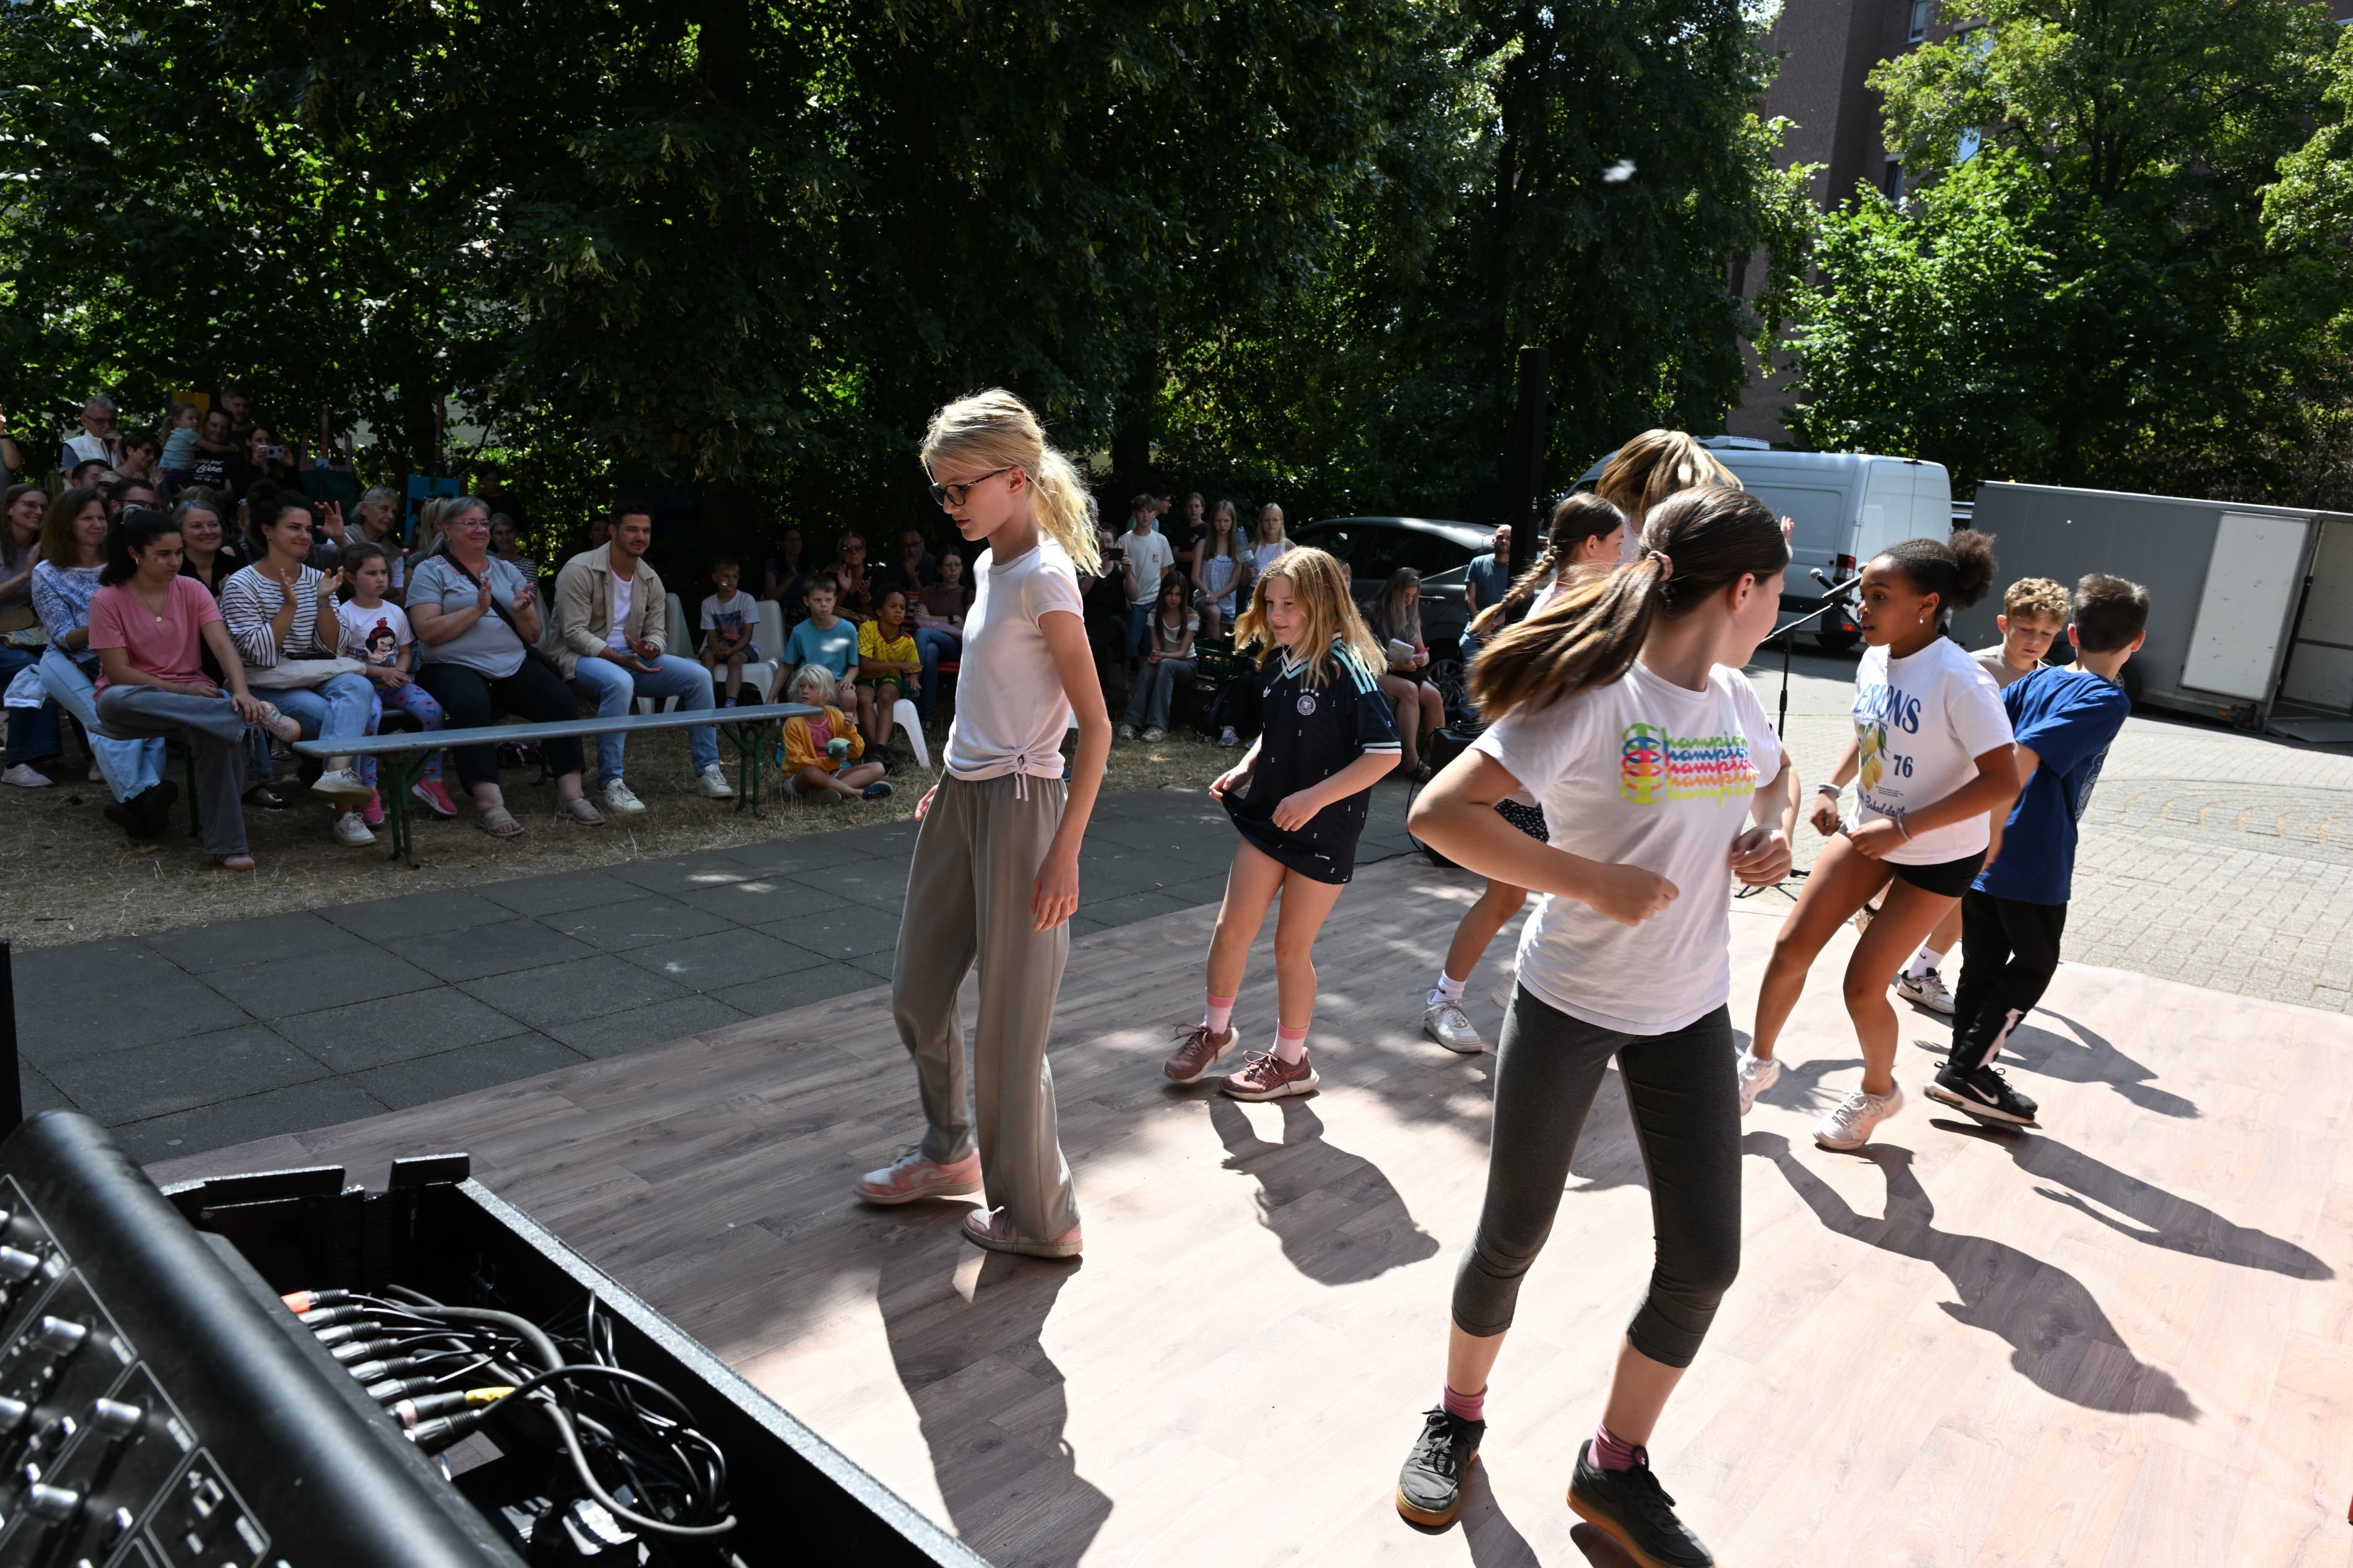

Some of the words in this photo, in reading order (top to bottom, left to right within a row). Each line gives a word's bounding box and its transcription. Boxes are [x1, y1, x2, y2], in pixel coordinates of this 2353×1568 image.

[1853, 683, 1921, 734] EMONS
[1894, 754, 1913, 778] 76
[1620, 776, 1756, 810] Champio
